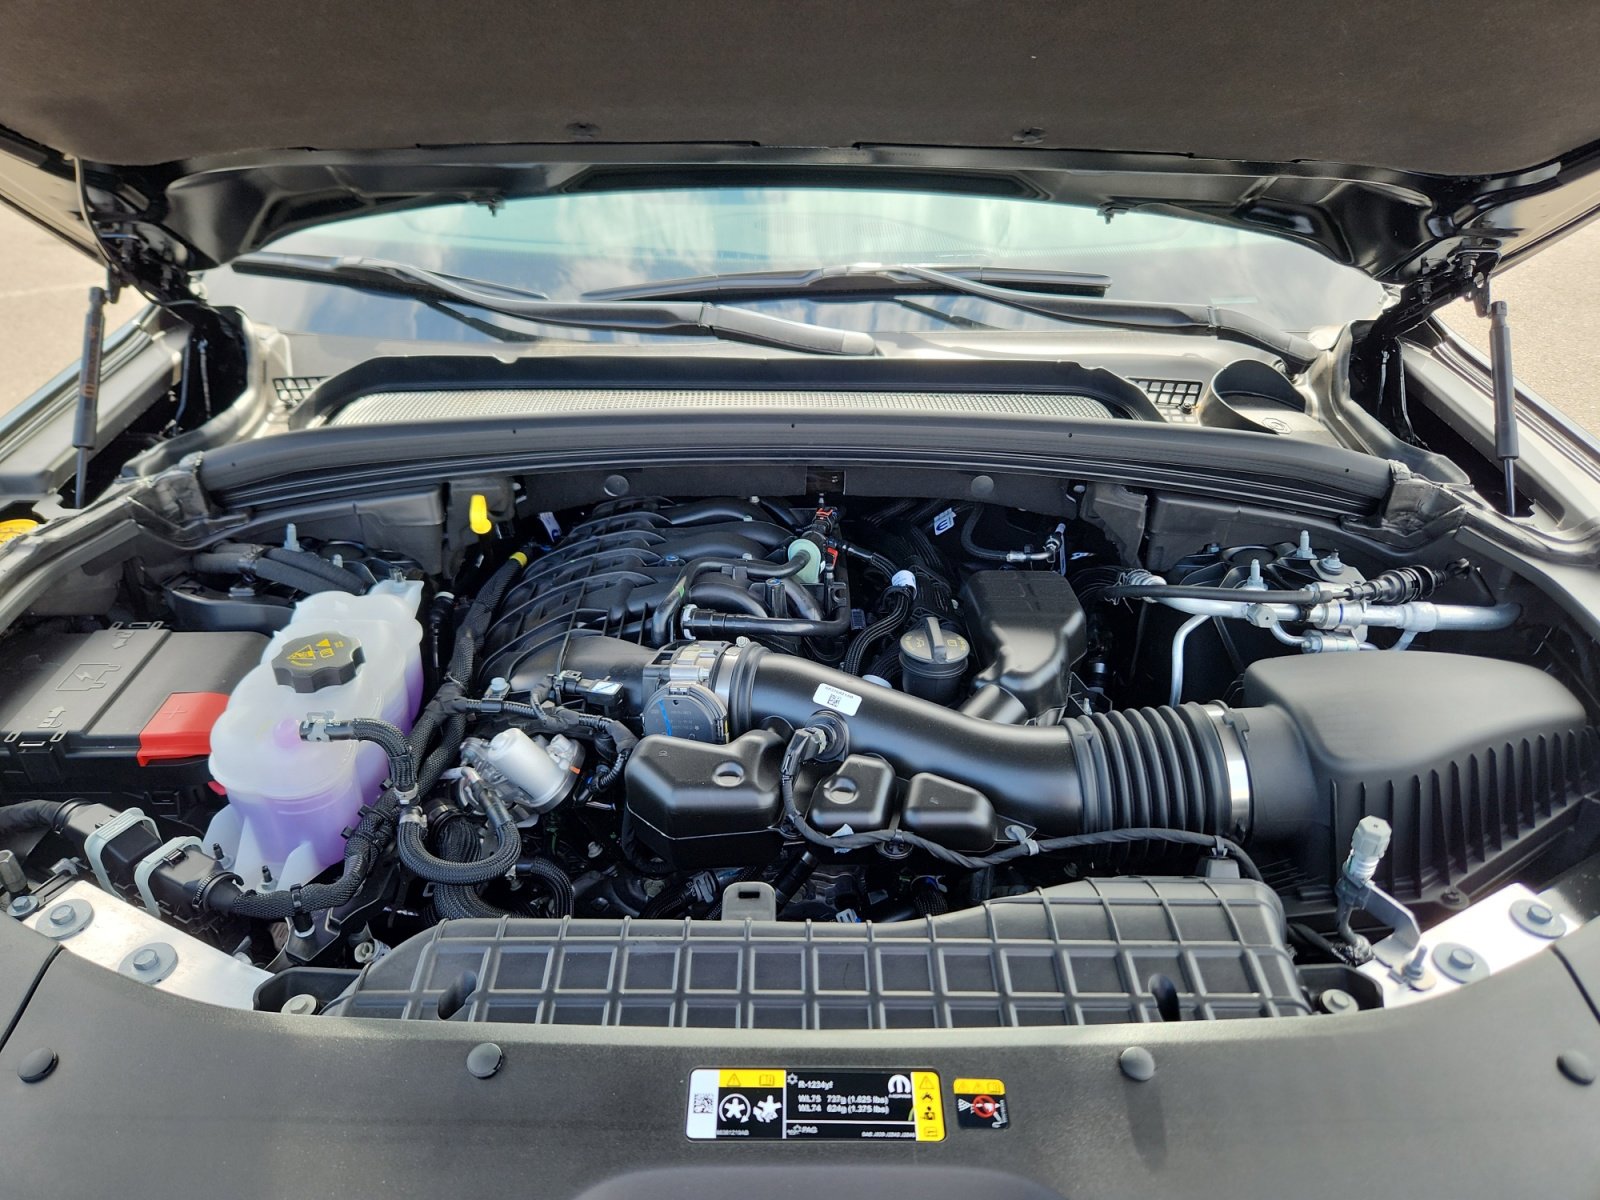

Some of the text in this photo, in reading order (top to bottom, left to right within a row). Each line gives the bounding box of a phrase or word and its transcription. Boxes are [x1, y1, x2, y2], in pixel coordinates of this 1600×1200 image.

[798, 1080, 834, 1091] R-1234yf
[798, 1094, 822, 1103] WL75
[872, 1095, 889, 1105] lbs)
[798, 1104, 822, 1112] WL74
[873, 1105, 890, 1115] lbs)
